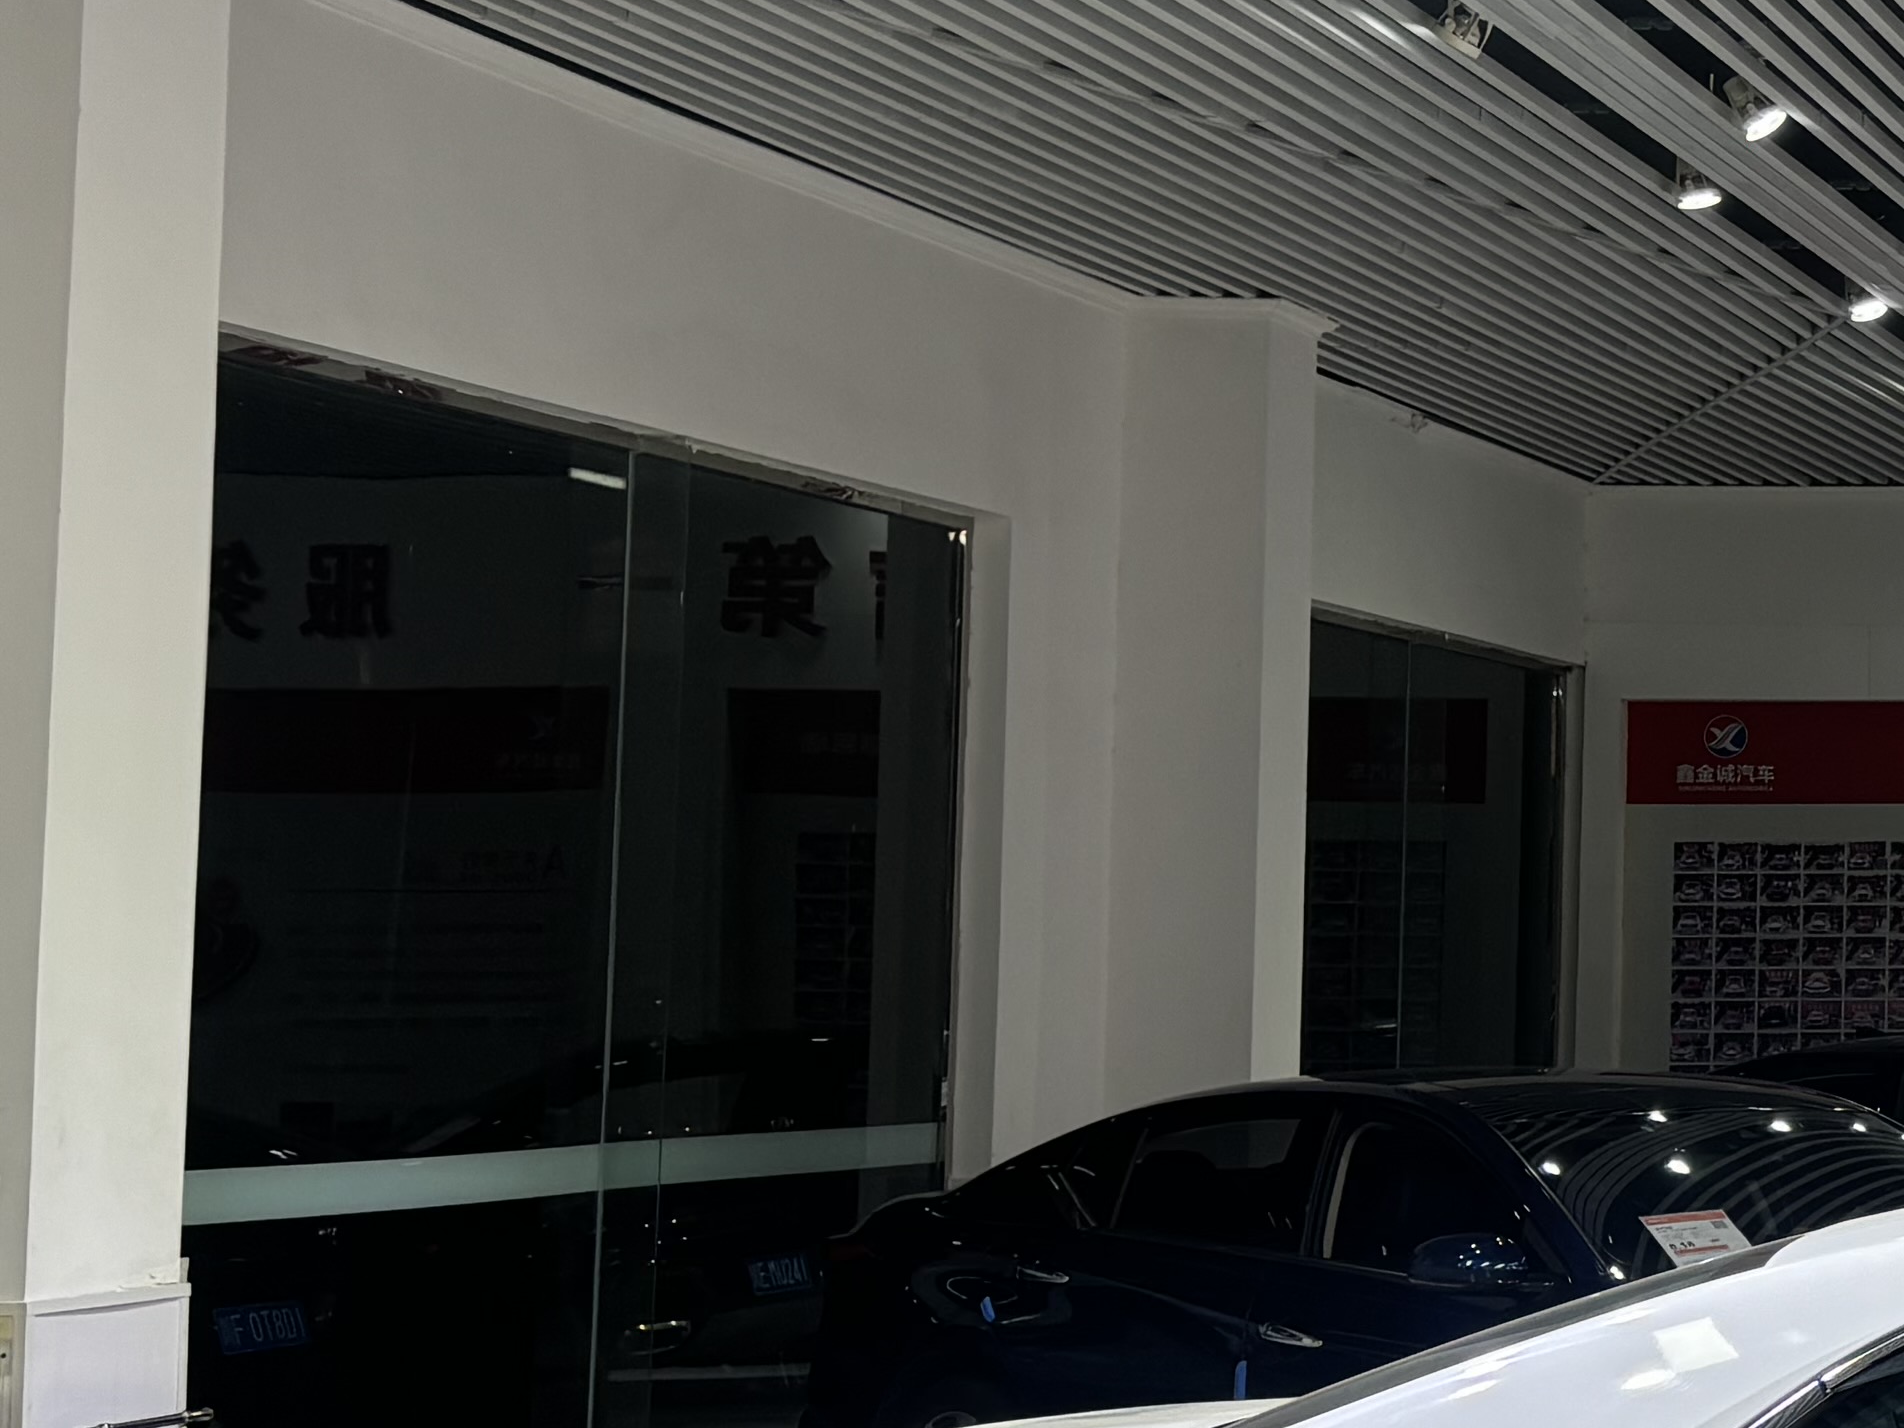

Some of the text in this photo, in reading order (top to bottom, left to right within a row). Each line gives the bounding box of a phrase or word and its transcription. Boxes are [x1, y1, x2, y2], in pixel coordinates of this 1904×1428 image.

[1676, 763, 1775, 783] 鑫金诚汽车
